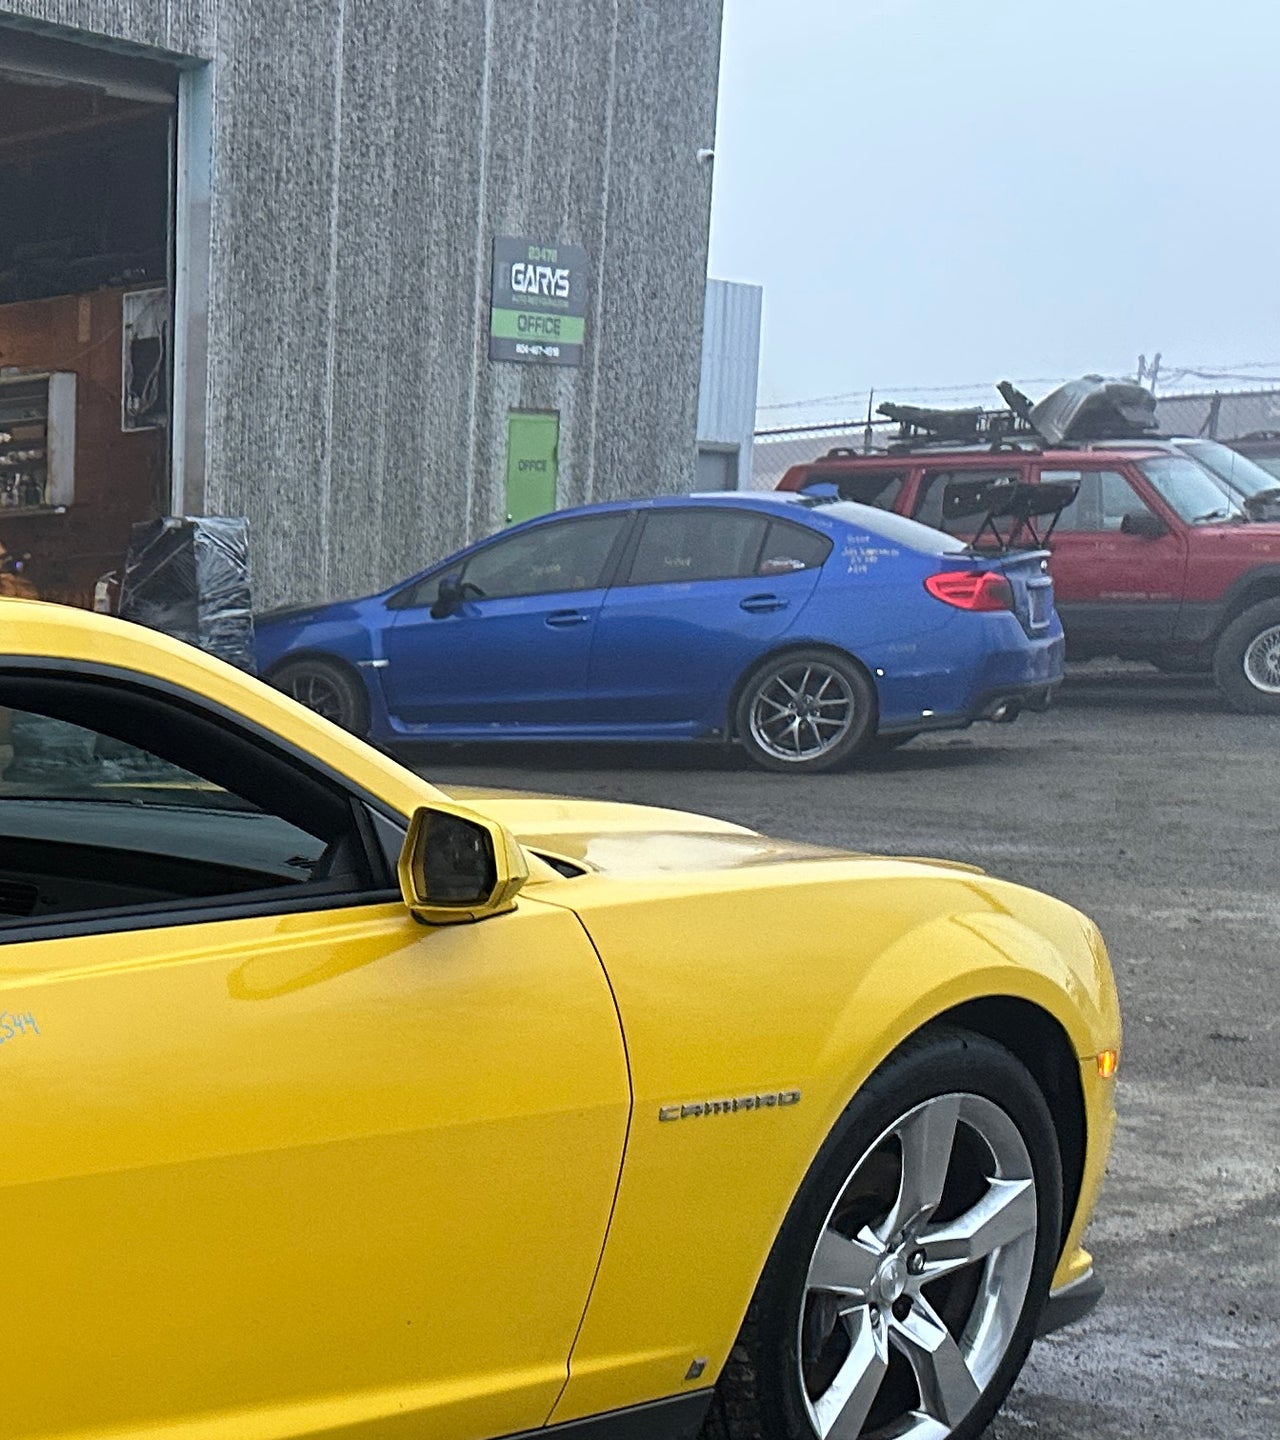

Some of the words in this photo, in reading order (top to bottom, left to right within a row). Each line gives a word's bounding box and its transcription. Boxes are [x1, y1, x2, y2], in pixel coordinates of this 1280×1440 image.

[511, 263, 570, 298] GARYS
[517, 314, 561, 336] OFFICE
[658, 1088, 802, 1122] CAMARO
